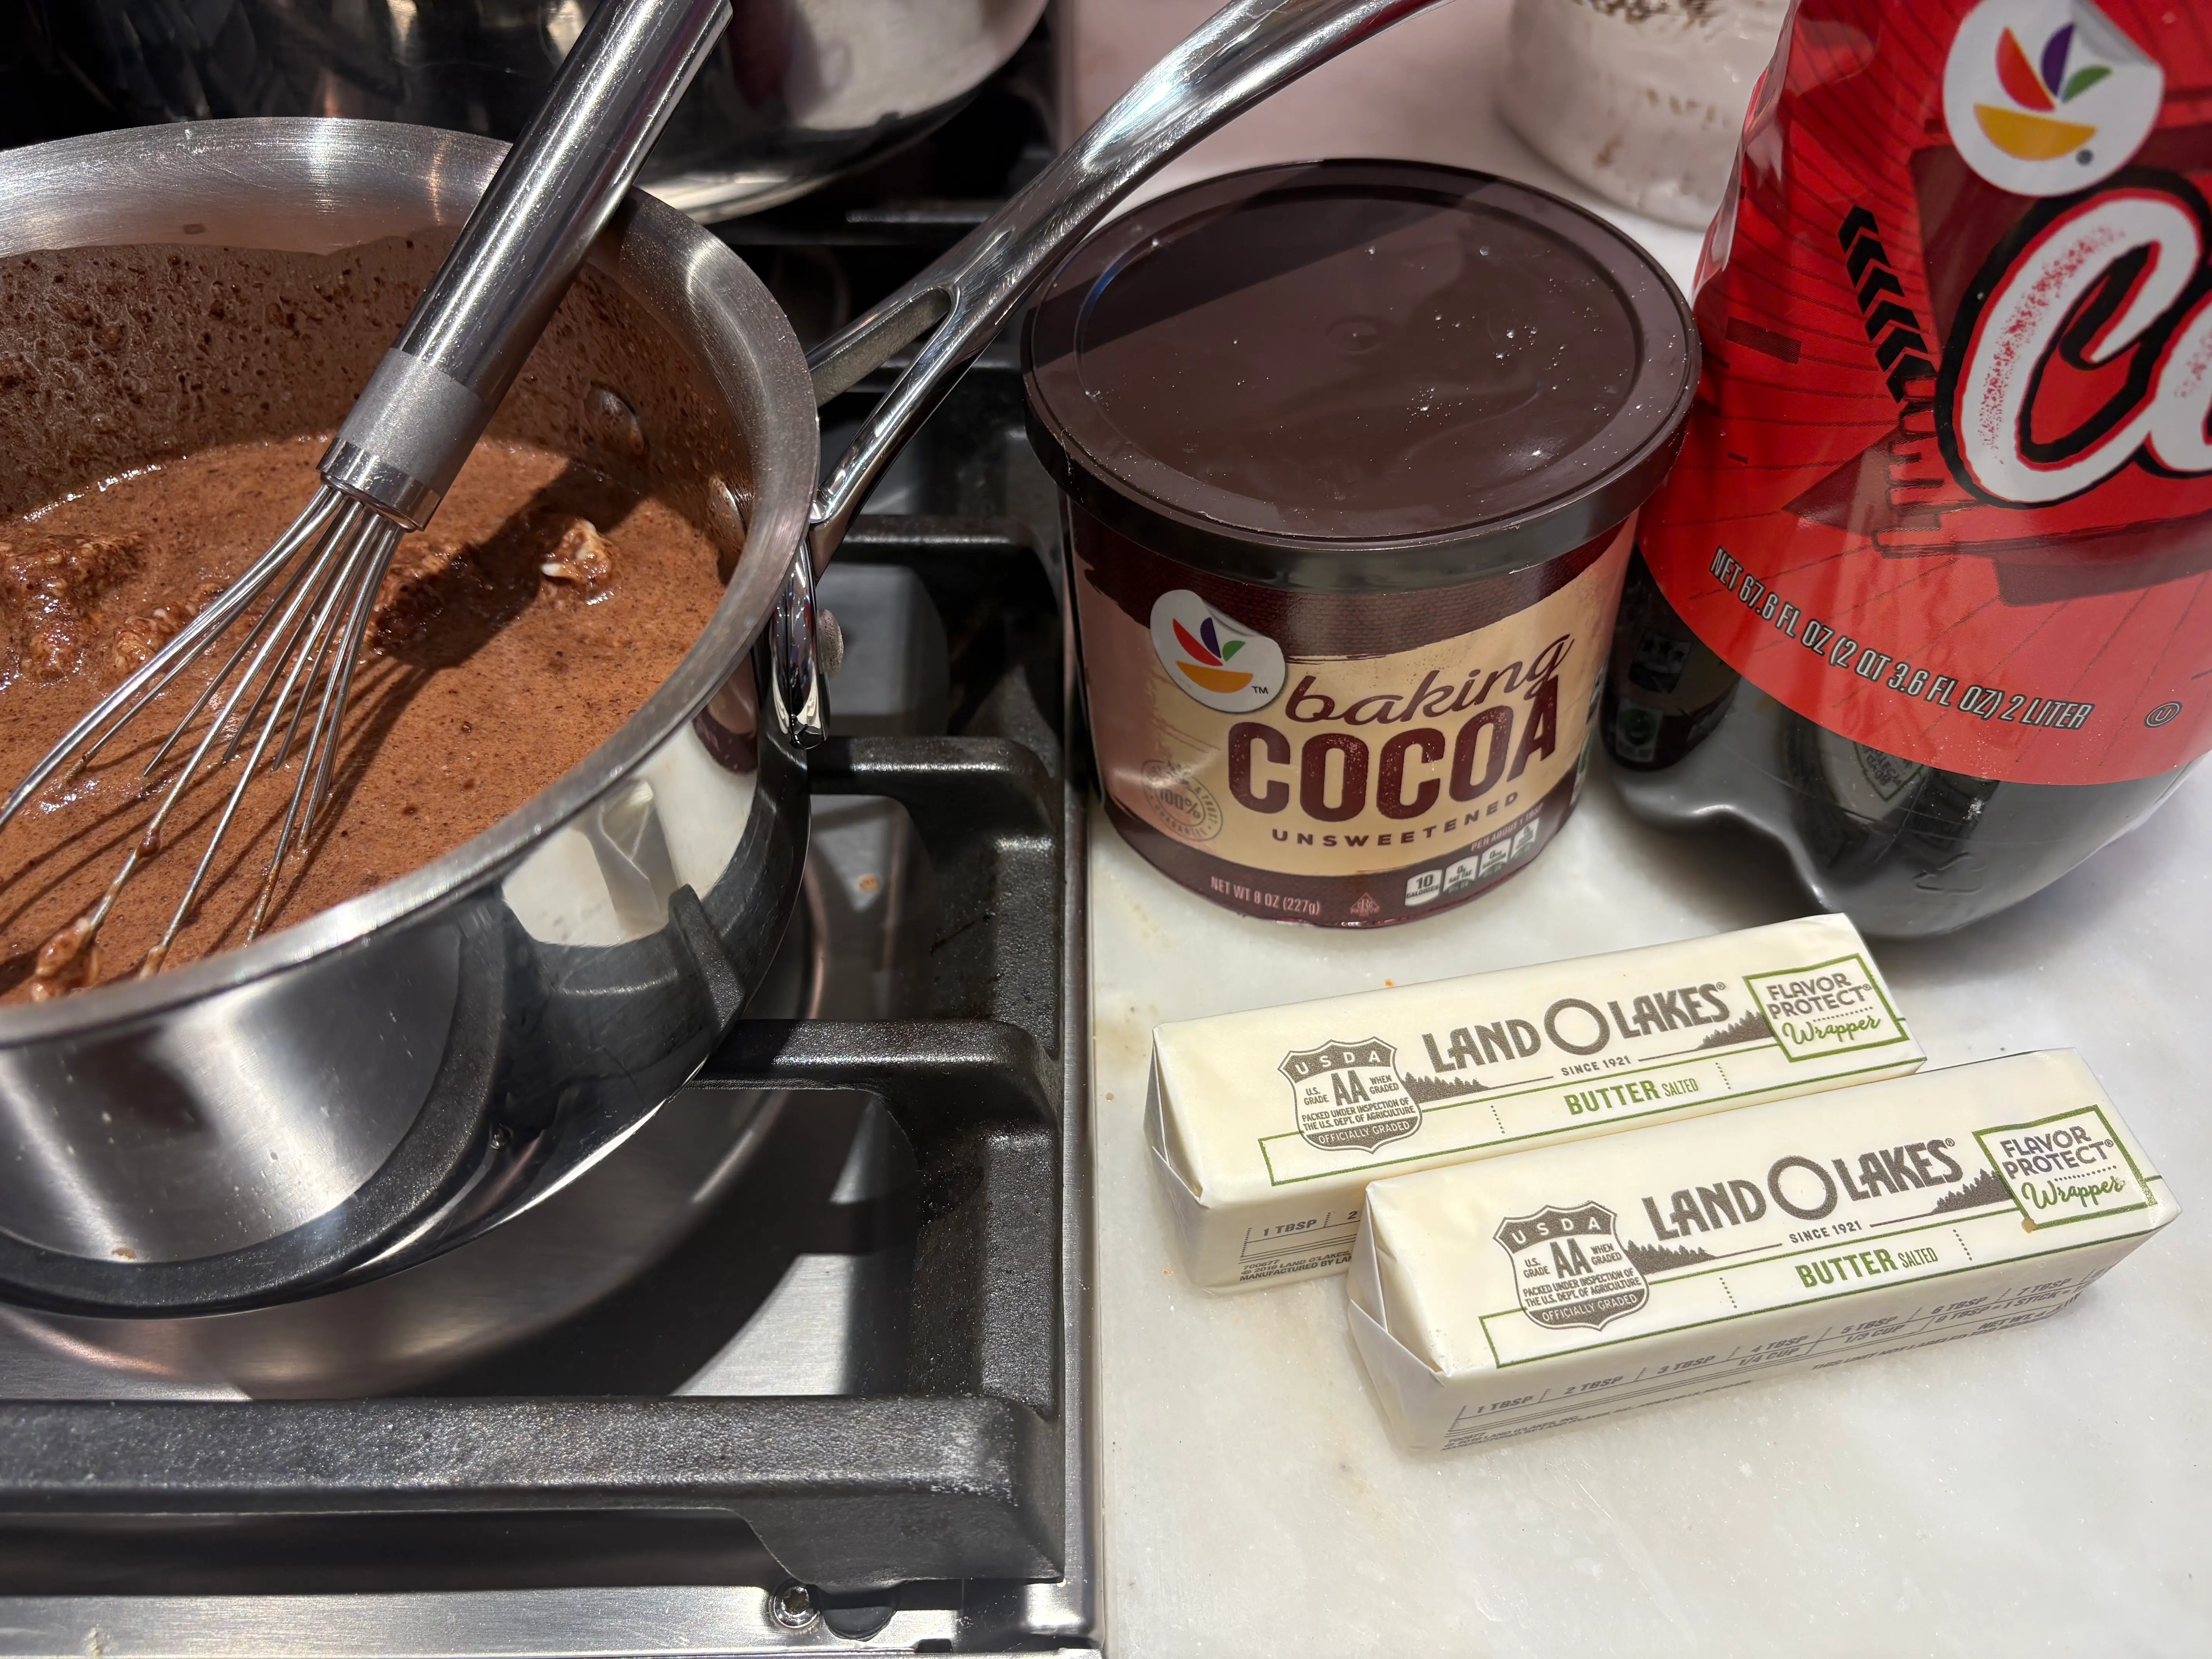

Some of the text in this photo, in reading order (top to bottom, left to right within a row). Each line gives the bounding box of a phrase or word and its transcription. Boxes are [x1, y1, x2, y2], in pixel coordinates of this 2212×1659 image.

[1709, 545, 2095, 730] NET 67.6 FL OZ (2 QT 3.6 FL OZ) 2 LITER
[1285, 633, 1575, 726] baking
[1228, 675, 1559, 823] COCOA
[1271, 792, 1518, 847] UNSWEETENED
[1416, 874, 1434, 890] 10
[1211, 876, 1321, 915] NET WT 8 OZ (227g)
[1766, 972, 1851, 1001] FLAVOR
[1422, 1019, 1541, 1073] LAND
[1544, 998, 1610, 1056] O
[1782, 1015, 1881, 1045] Wrapper
[1295, 1051, 1380, 1074] USDA
[1561, 1055, 1632, 1076] SINCE 1921
[1306, 1087, 1321, 1096] U.S.
[1331, 1070, 1370, 1106] AA
[1369, 1075, 1392, 1085] WHEN
[1370, 1082, 1399, 1094] GRADED
[1304, 1095, 1329, 1106] GRADE
[1563, 1078, 1699, 1115] BUTTER SALTED
[1302, 1097, 1410, 1122] PACKED UNDER INSPECTION OF
[1303, 1106, 1416, 1131] THE U.S. DEPT. OF AGRICULTURE
[1318, 1121, 1409, 1144] OFFICIALLY GRADED
[2000, 1126, 2092, 1158] FLAVOR
[1641, 1180, 1767, 1241] LAND
[1767, 1154, 1838, 1220] O
[2021, 1176, 2125, 1209] Wrapper
[1275, 1219, 1317, 1233] TBSP
[1347, 1211, 1358, 1219] 2
[1512, 1217, 1601, 1244] USDA
[1789, 1221, 1862, 1244] SINCE 1921
[1549, 1238, 1593, 1279] AA
[1590, 1243, 1614, 1255] WHEN
[1591, 1252, 1622, 1265] GRADED
[1240, 1262, 1318, 1281] MANUFACTURED
[1243, 1259, 1280, 1270] 700677
[1253, 1265, 1278, 1273] 2019
[1279, 1259, 1307, 1268] LAND
[1523, 1266, 1550, 1279] GRADE
[1525, 1258, 1541, 1267] U.S.
[1795, 1247, 1938, 1288] BUTTER SALTED
[1523, 1267, 1635, 1297] PACKED UNDER INSPECTION OF
[1525, 1298, 1541, 1307] THE
[1541, 1295, 1557, 1305] U.S.
[1579, 1287, 1589, 1297] OF
[1591, 1277, 1641, 1295] AGRICULTURE
[2034, 1278, 2072, 1292] TBSP
[1542, 1294, 1637, 1321] OFFICIALLY GRADED
[1946, 1297, 1988, 1312] TBSP
[1949, 1306, 1991, 1320] TBSP
[2014, 1291, 2059, 1307] STICK
[1841, 1316, 1898, 1334] 5 TBSP
[1870, 1324, 1905, 1337] CUP
[1765, 1348, 1800, 1360] CUP
[1766, 1335, 1809, 1350] TBSP
[1657, 1355, 1716, 1374] 3 TBSP
[1580, 1376, 1623, 1391] TBSP
[1490, 1395, 1534, 1410] TBSP
